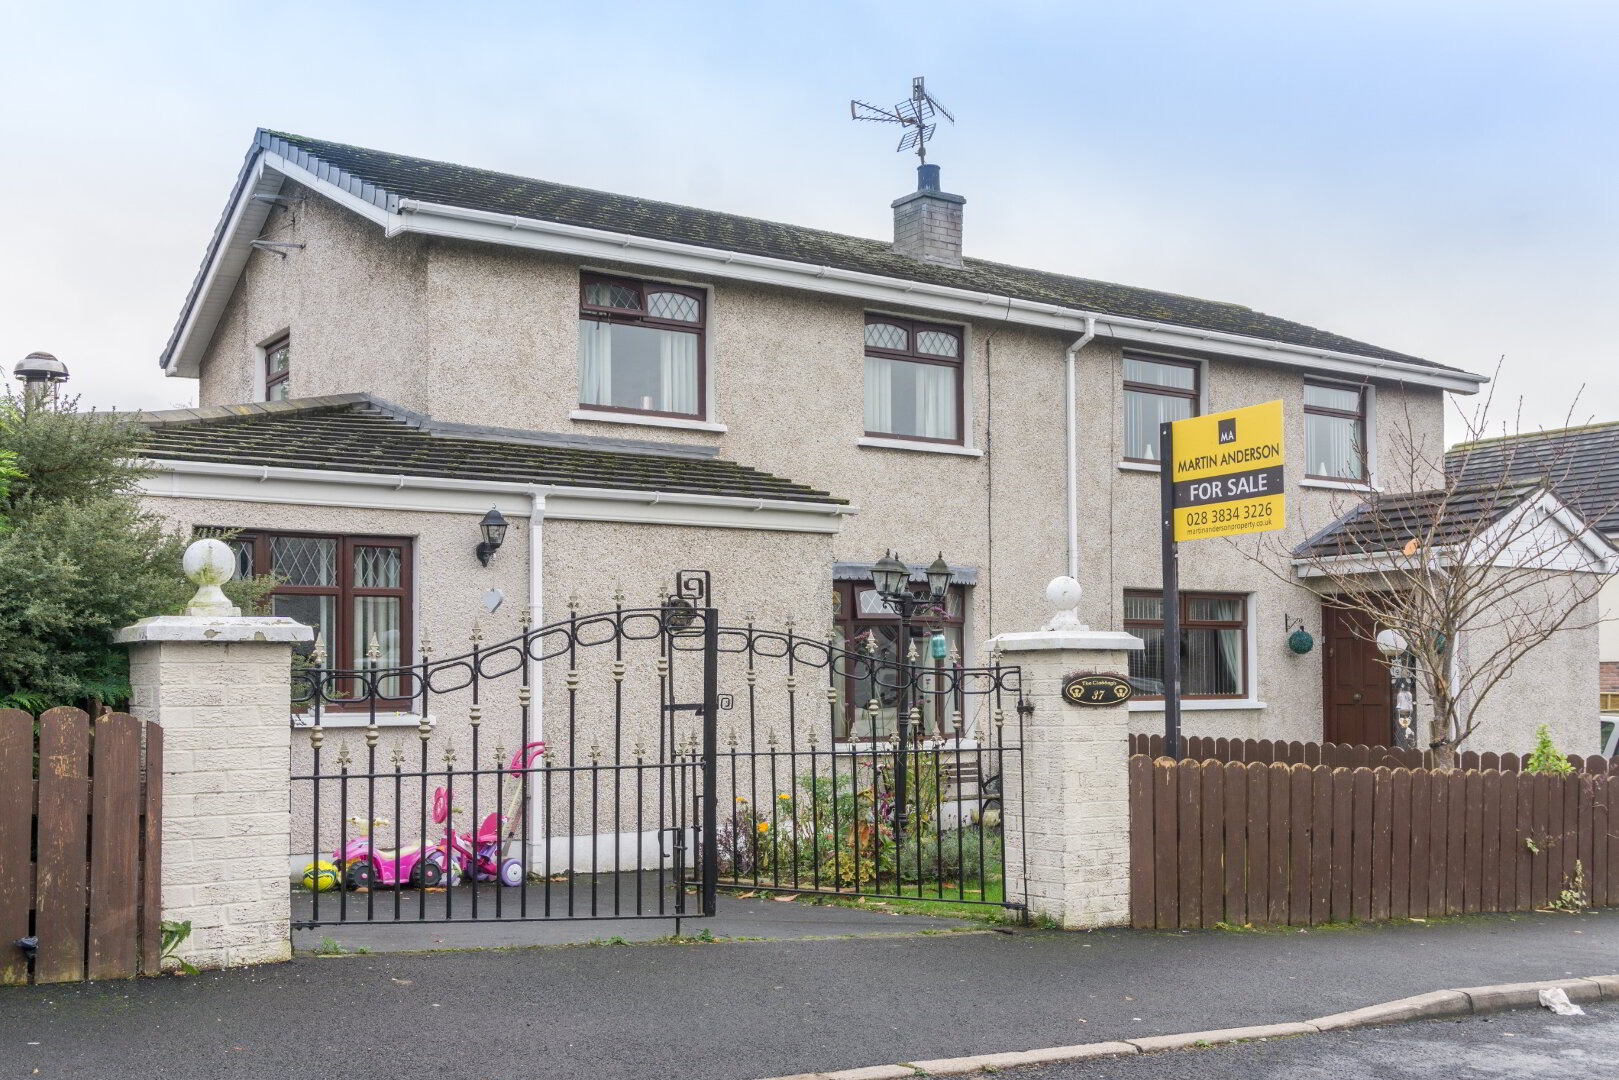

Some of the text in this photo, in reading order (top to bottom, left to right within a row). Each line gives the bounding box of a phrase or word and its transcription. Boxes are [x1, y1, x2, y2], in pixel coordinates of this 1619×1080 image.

[1220, 430, 1234, 442] MA
[1177, 443, 1280, 473] MARTIN ANDERSON
[1190, 473, 1267, 501] FOR SALE
[1186, 502, 1272, 527] 028 3834 3226
[1187, 518, 1272, 535] martinandersonproperty.co.uk
[1091, 690, 1105, 700] 37
